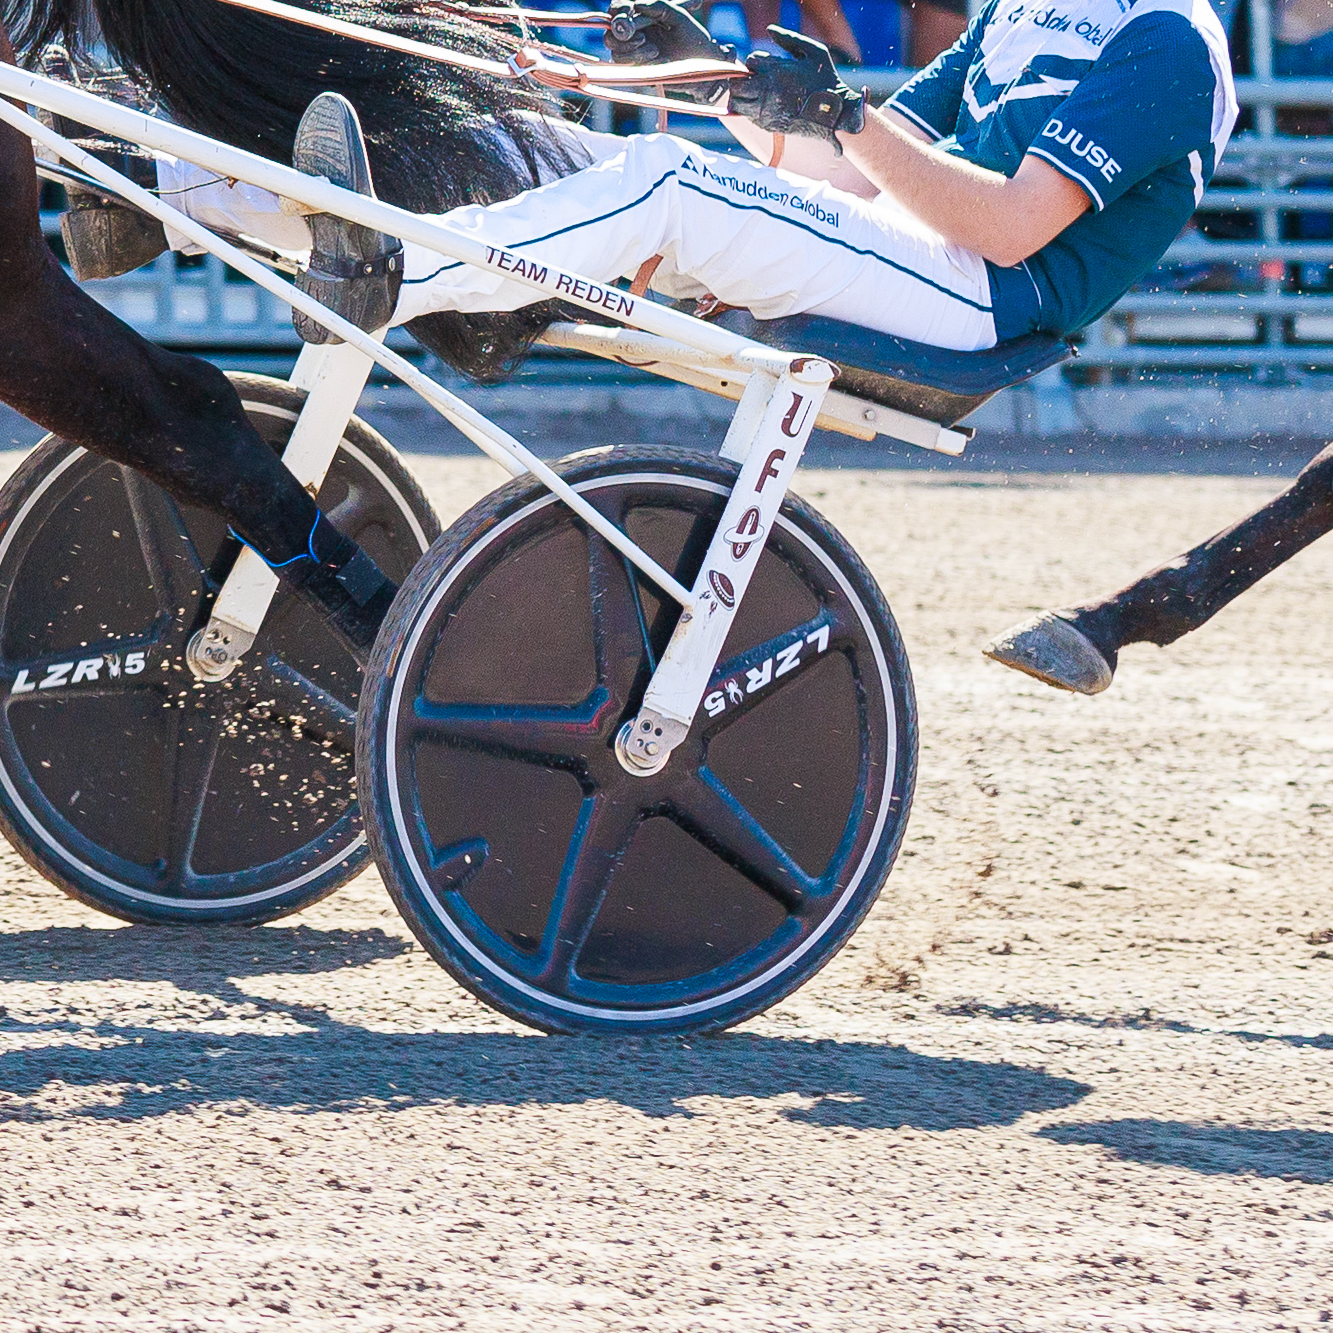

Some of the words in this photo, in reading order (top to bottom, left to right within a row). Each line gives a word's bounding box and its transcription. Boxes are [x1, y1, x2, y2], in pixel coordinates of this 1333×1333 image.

[1041, 118, 1122, 184] DJUSE
[790, 195, 839, 228] Global
[486, 246, 548, 284] TEAM
[555, 273, 634, 317] REDEN
[10, 657, 104, 694] LZR
[745, 624, 830, 694] LZR
